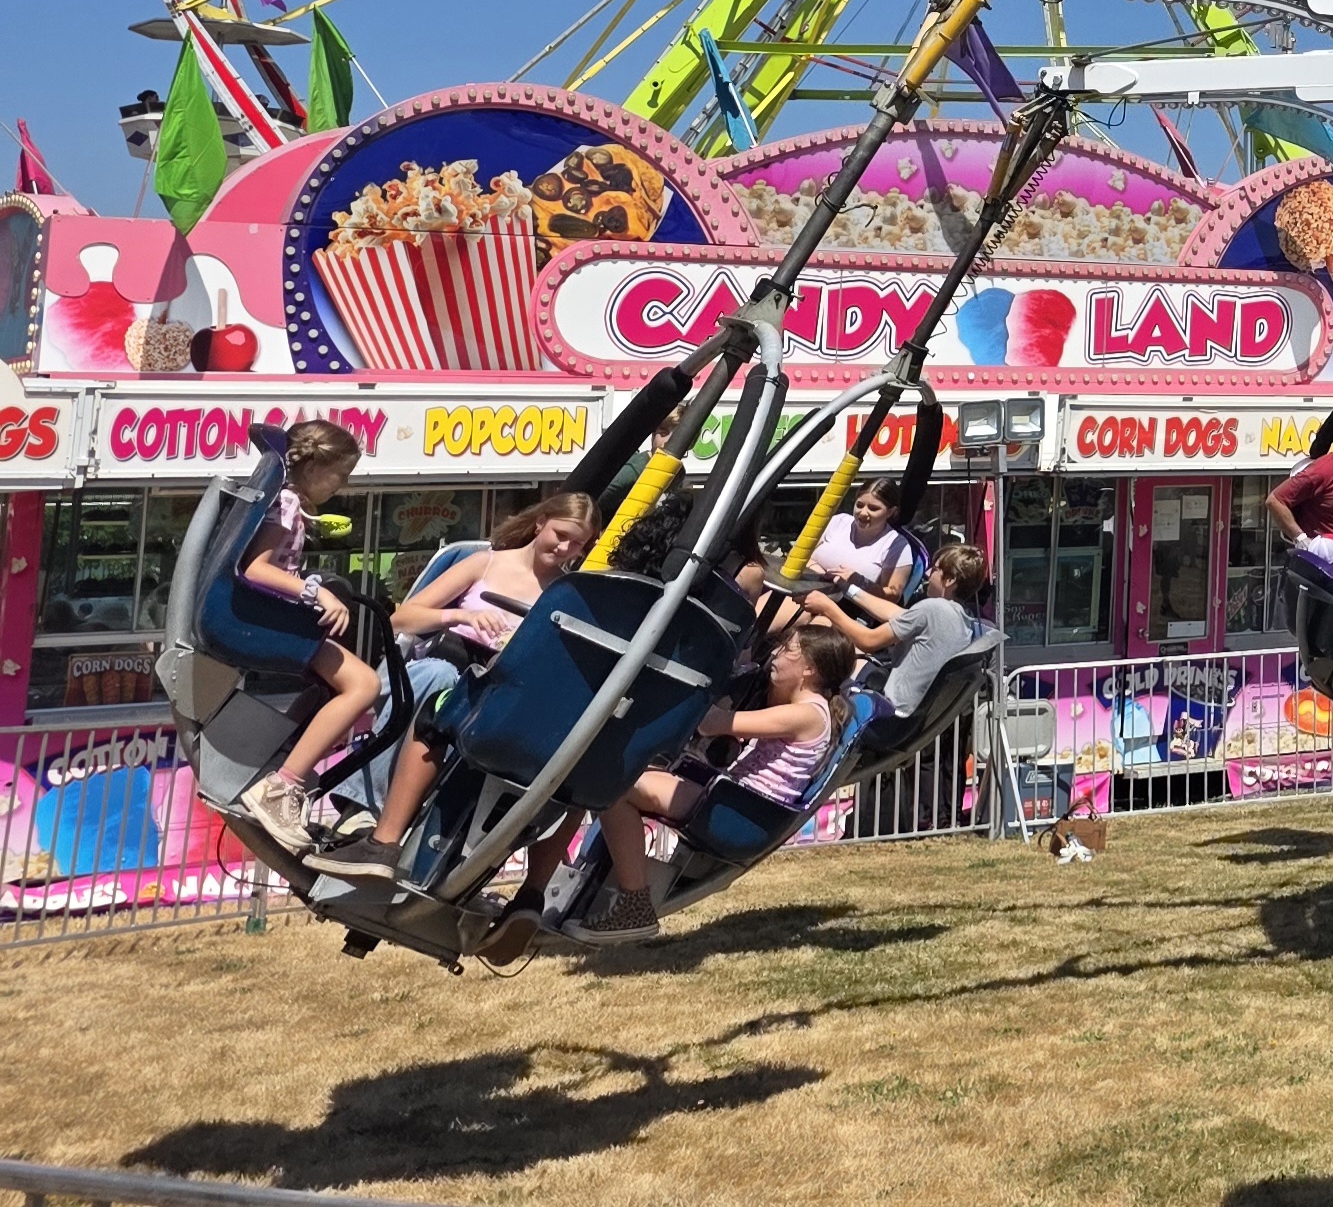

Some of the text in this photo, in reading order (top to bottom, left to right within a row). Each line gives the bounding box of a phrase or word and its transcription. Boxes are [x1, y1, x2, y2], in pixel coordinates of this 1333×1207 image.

[607, 268, 1290, 363] CANDY LAND
[110, 406, 252, 461] COTTON
[424, 405, 588, 457] POPCORN
[846, 412, 917, 457] HOT
[1077, 415, 1239, 458] CORN DOGS
[73, 658, 152, 677] CORN DOGS
[1103, 664, 1238, 700] COLD DRINKS
[47, 736, 168, 786] COTTON
